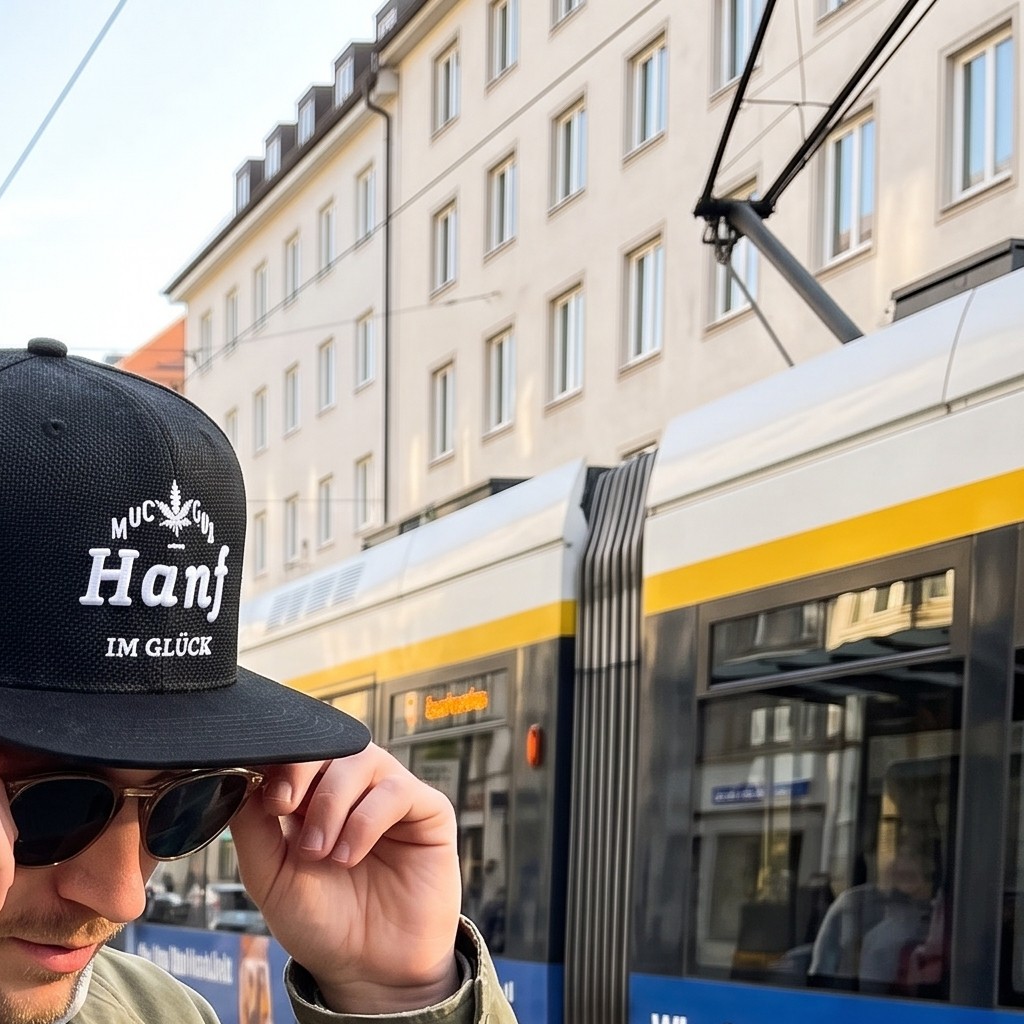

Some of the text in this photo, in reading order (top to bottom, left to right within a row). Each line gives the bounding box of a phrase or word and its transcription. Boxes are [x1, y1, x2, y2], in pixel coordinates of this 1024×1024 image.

[111, 499, 156, 540] MUC
[79, 545, 230, 623] Hanf
[105, 632, 212, 658] IM GLÜCK
